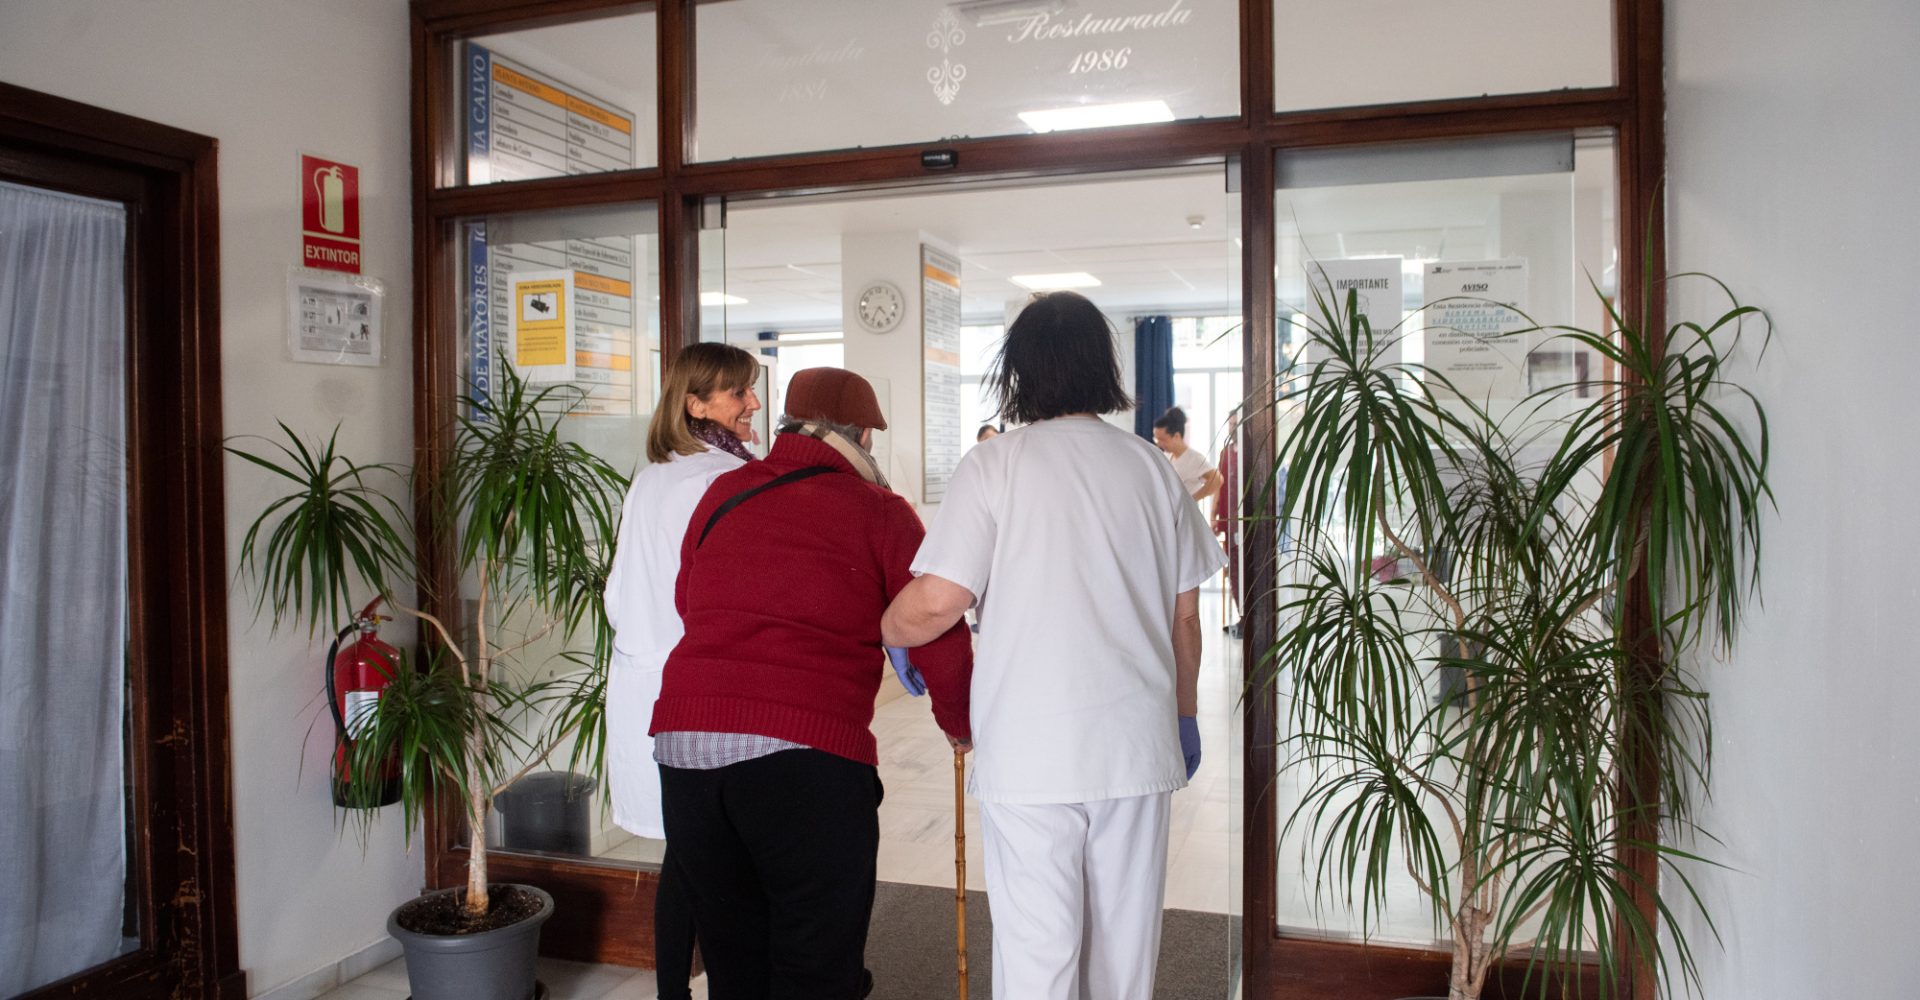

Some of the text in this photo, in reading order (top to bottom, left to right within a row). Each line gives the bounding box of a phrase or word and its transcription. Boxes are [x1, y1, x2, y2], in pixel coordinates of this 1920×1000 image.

[1007, 0, 1192, 42] Restaurada
[1069, 47, 1132, 74] 1986
[473, 55, 486, 124] CALVO
[305, 244, 358, 265] EXTINTOR
[1336, 278, 1389, 290] IMPORTANTE
[1461, 283, 1488, 292] AVISO
[475, 265, 488, 360] MAYORES
[476, 366, 489, 395] DE
